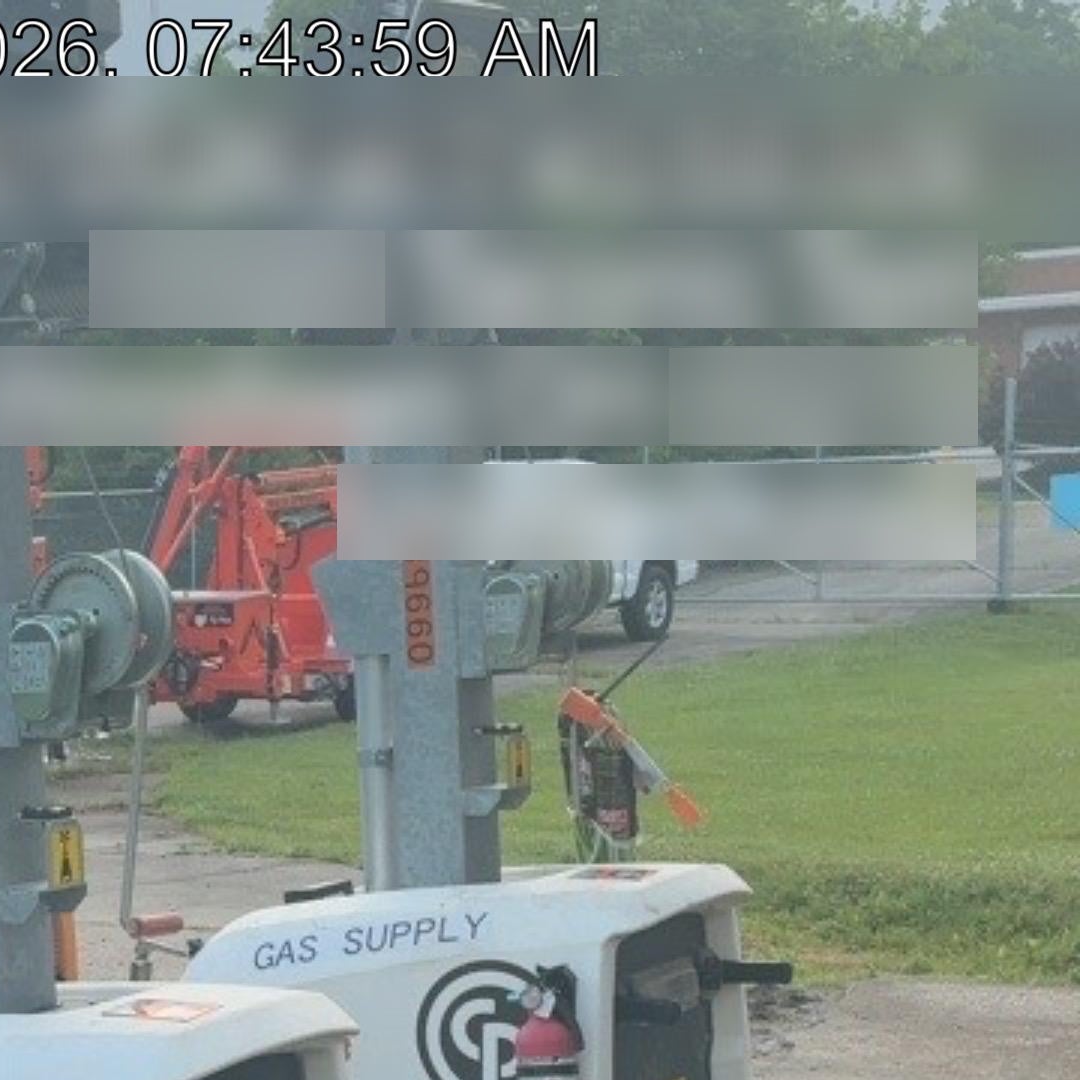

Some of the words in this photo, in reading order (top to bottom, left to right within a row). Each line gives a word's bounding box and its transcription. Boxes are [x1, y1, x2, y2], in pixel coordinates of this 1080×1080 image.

[404, 560, 433, 664] 9660
[254, 935, 319, 970] GAS
[343, 911, 489, 955] SUPPLY
